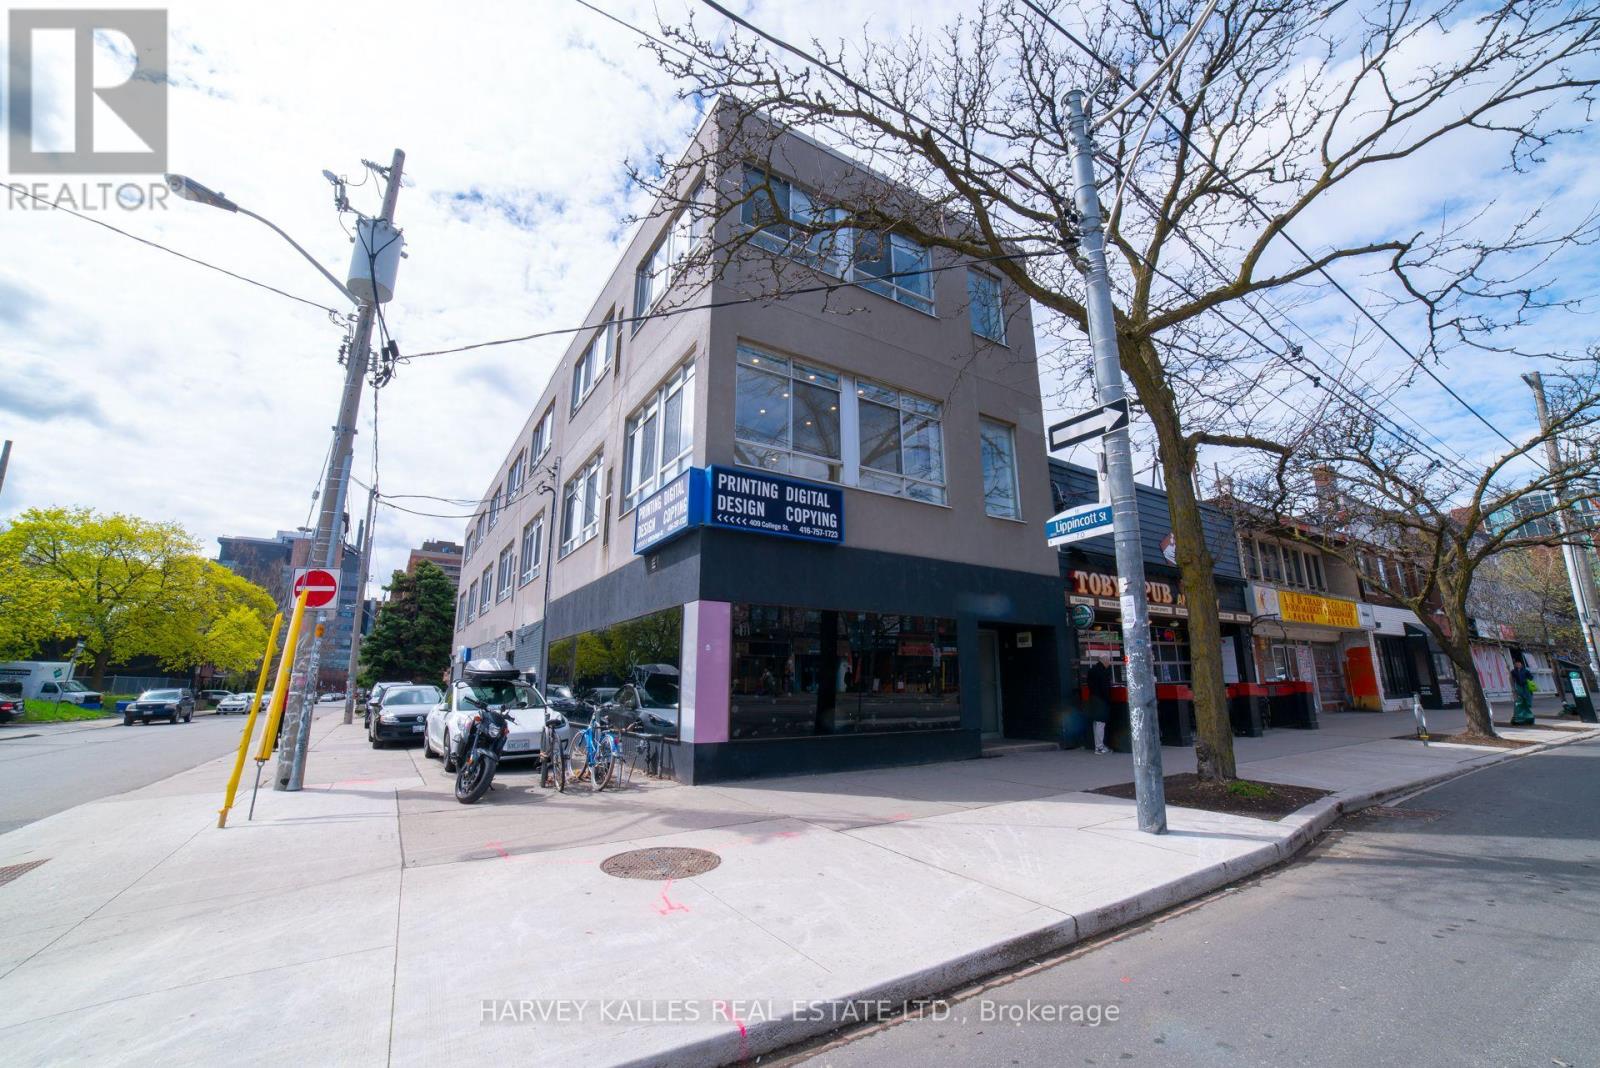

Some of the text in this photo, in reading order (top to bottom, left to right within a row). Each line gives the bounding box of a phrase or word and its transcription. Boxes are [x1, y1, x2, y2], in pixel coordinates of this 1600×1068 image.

[638, 480, 685, 522] PRINTING DIGITAL
[718, 473, 831, 508] PRINTING DIGITAL
[717, 494, 838, 529] DESIGN COPYING
[761, 521, 782, 531] College
[1055, 511, 1108, 534] Lippincott St
